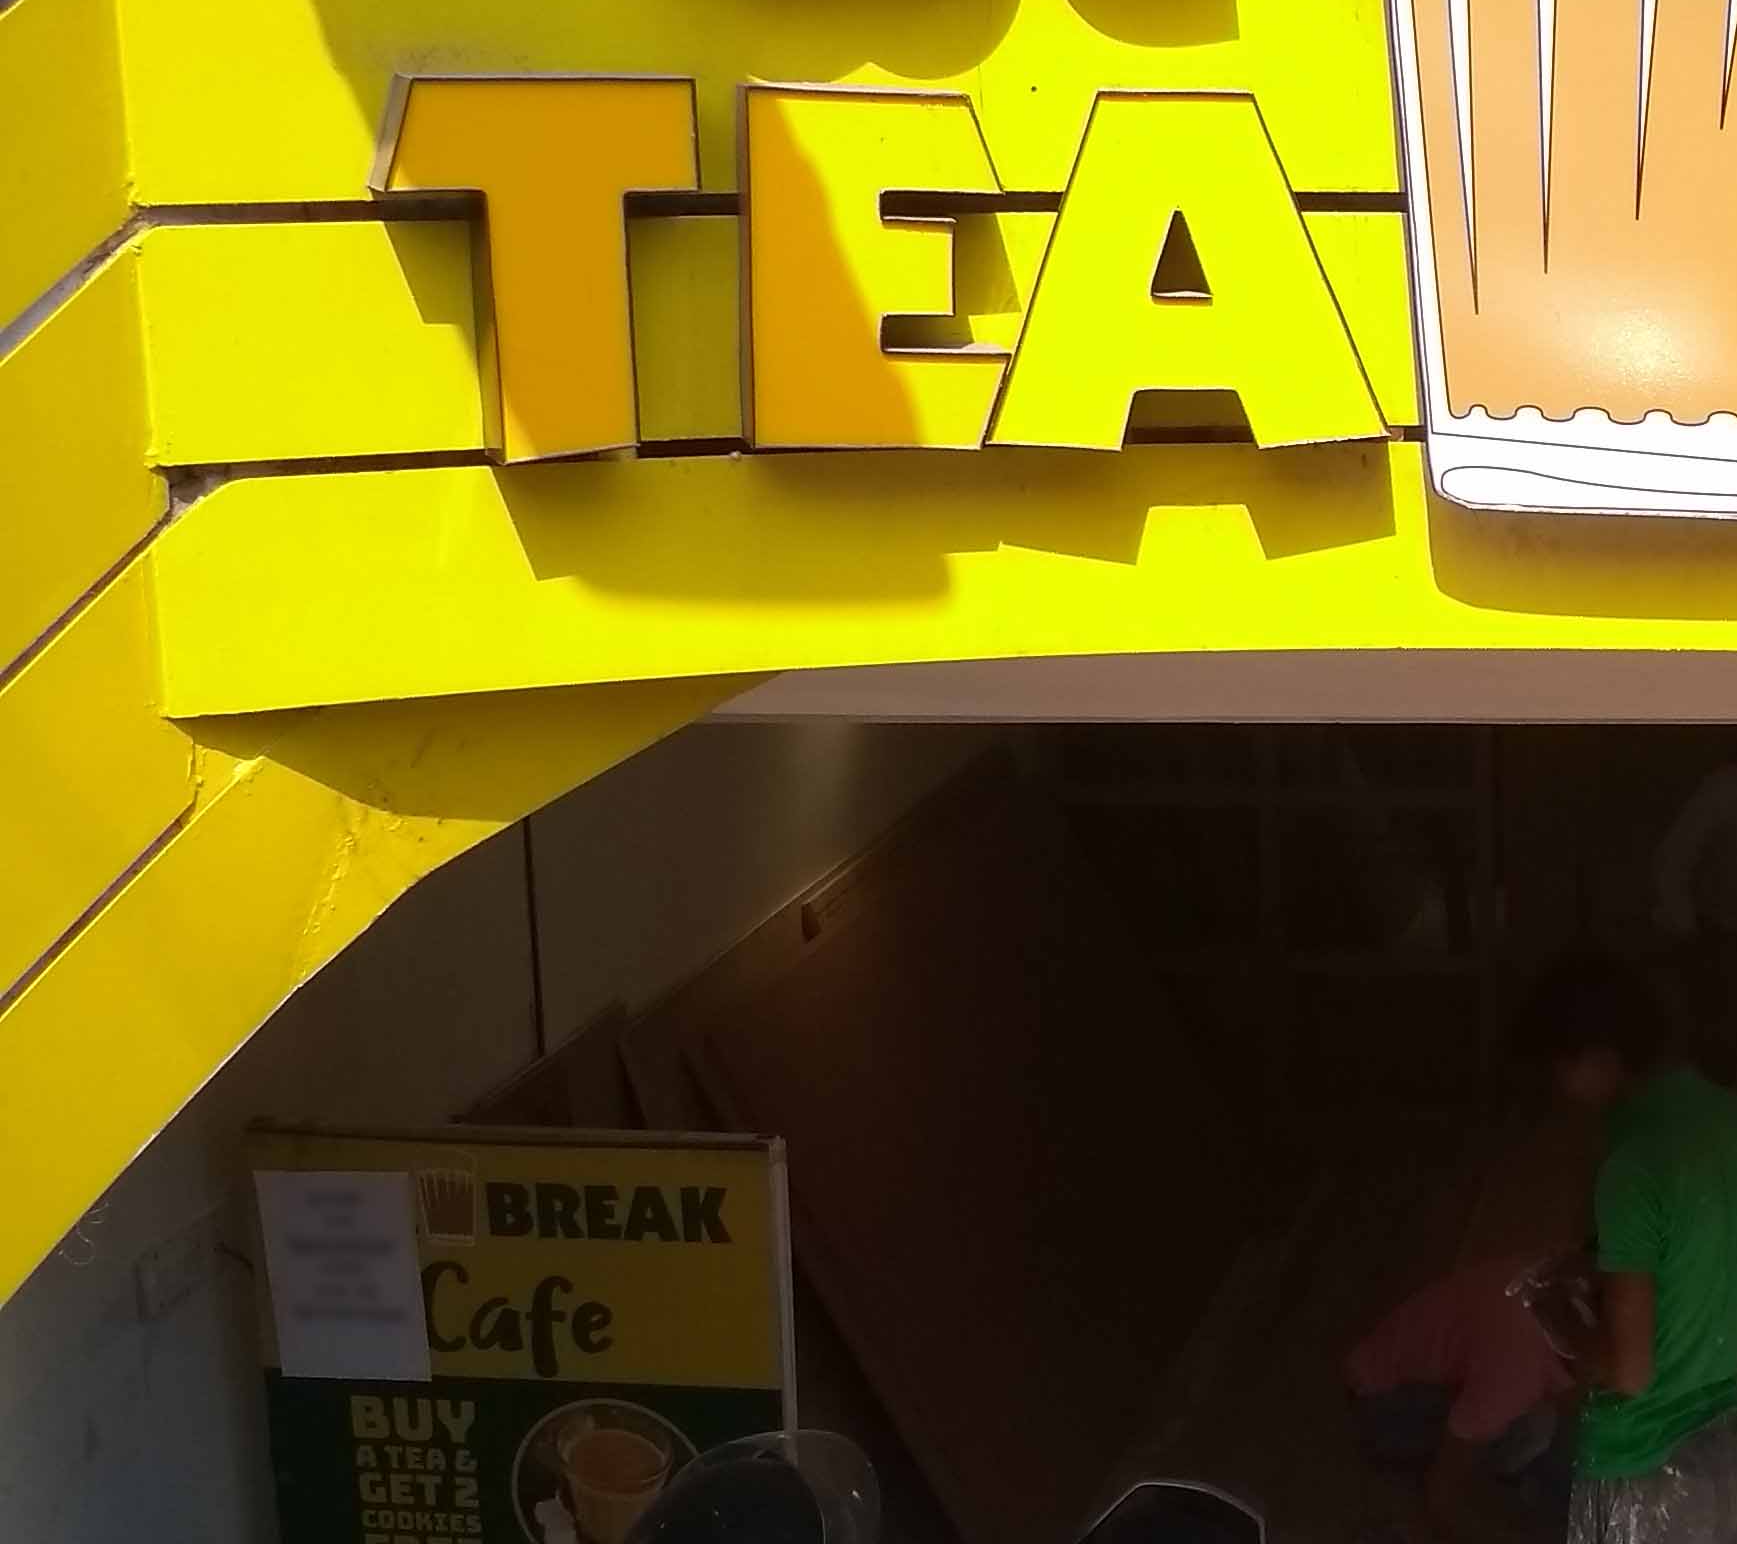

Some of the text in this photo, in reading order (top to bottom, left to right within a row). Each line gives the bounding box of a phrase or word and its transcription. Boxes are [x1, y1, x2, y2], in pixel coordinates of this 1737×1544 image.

[367, 73, 1394, 465] TEA
[485, 1181, 733, 1244] BREAK
[421, 1259, 613, 1379] Cafe
[350, 1394, 476, 1444] BUY
[354, 1445, 378, 1469] A
[382, 1444, 447, 1473] TEA
[358, 1472, 480, 1508] GET 2
[360, 1508, 483, 1534] COOKIES
